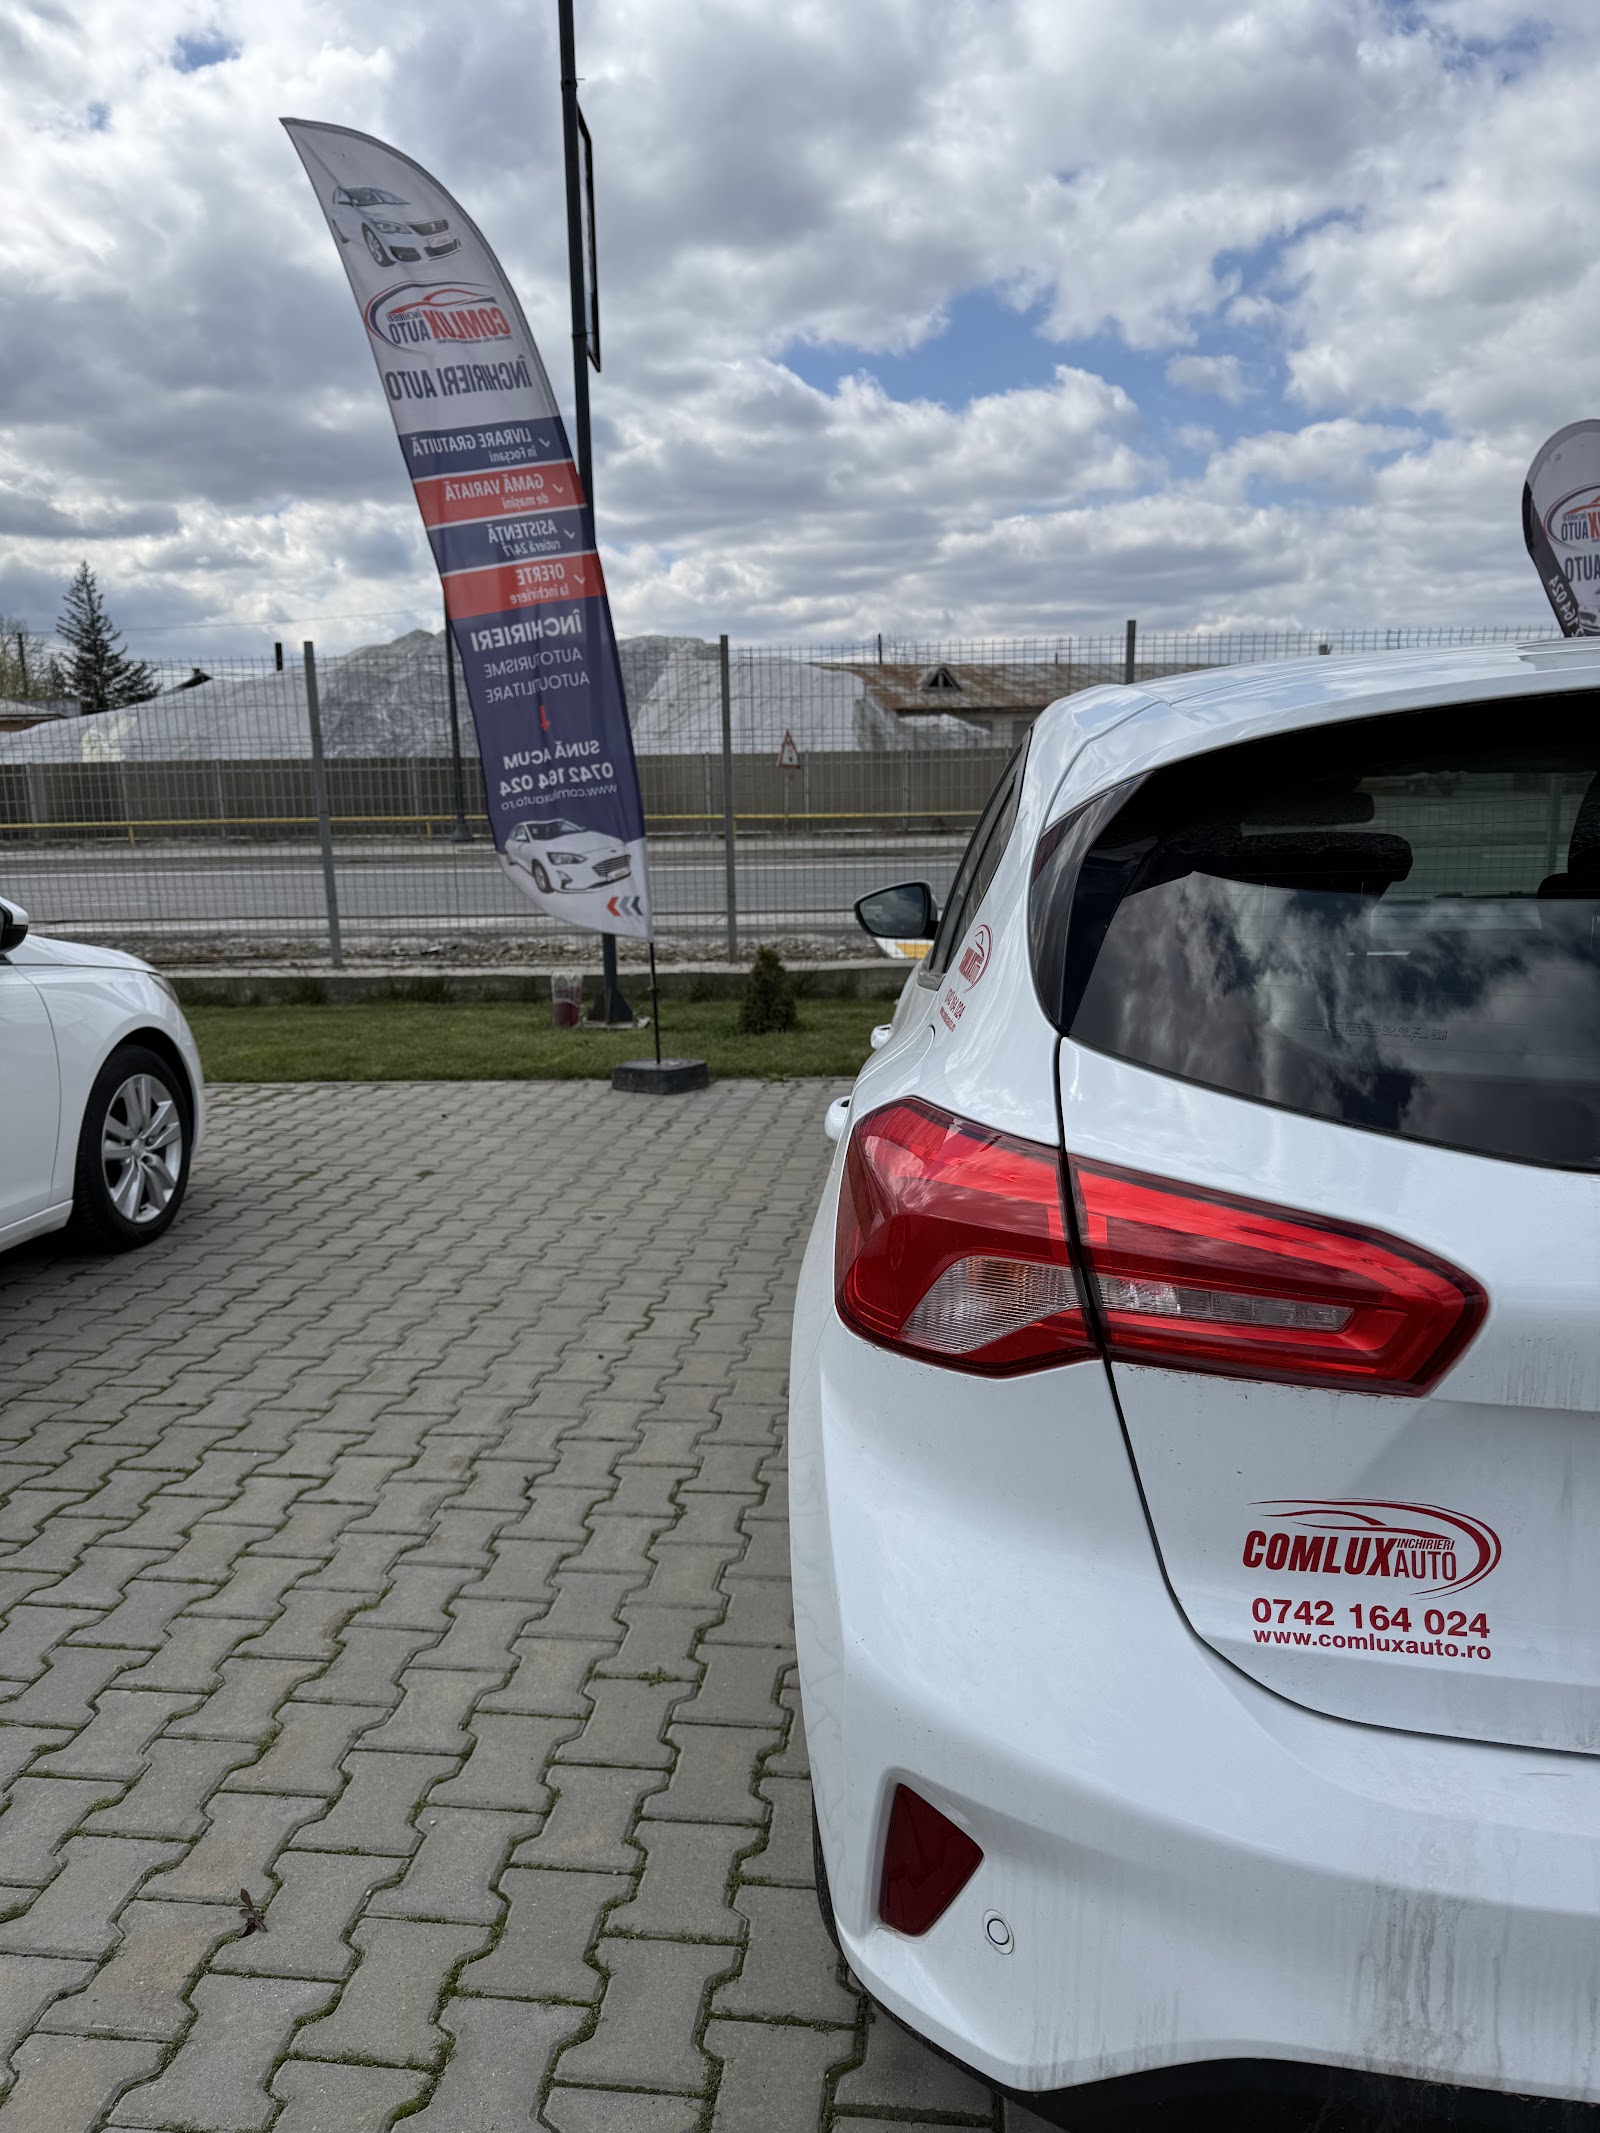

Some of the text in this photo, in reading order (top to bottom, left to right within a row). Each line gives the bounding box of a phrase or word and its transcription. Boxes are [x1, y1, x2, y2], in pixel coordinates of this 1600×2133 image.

[1242, 1530, 1457, 1582] COMLUX AUTO
[1396, 1537, 1456, 1552] INCHIRIERI
[1251, 1597, 1491, 1639] 0742 164 024
[1252, 1629, 1492, 1660] www.comluxauto.ro
